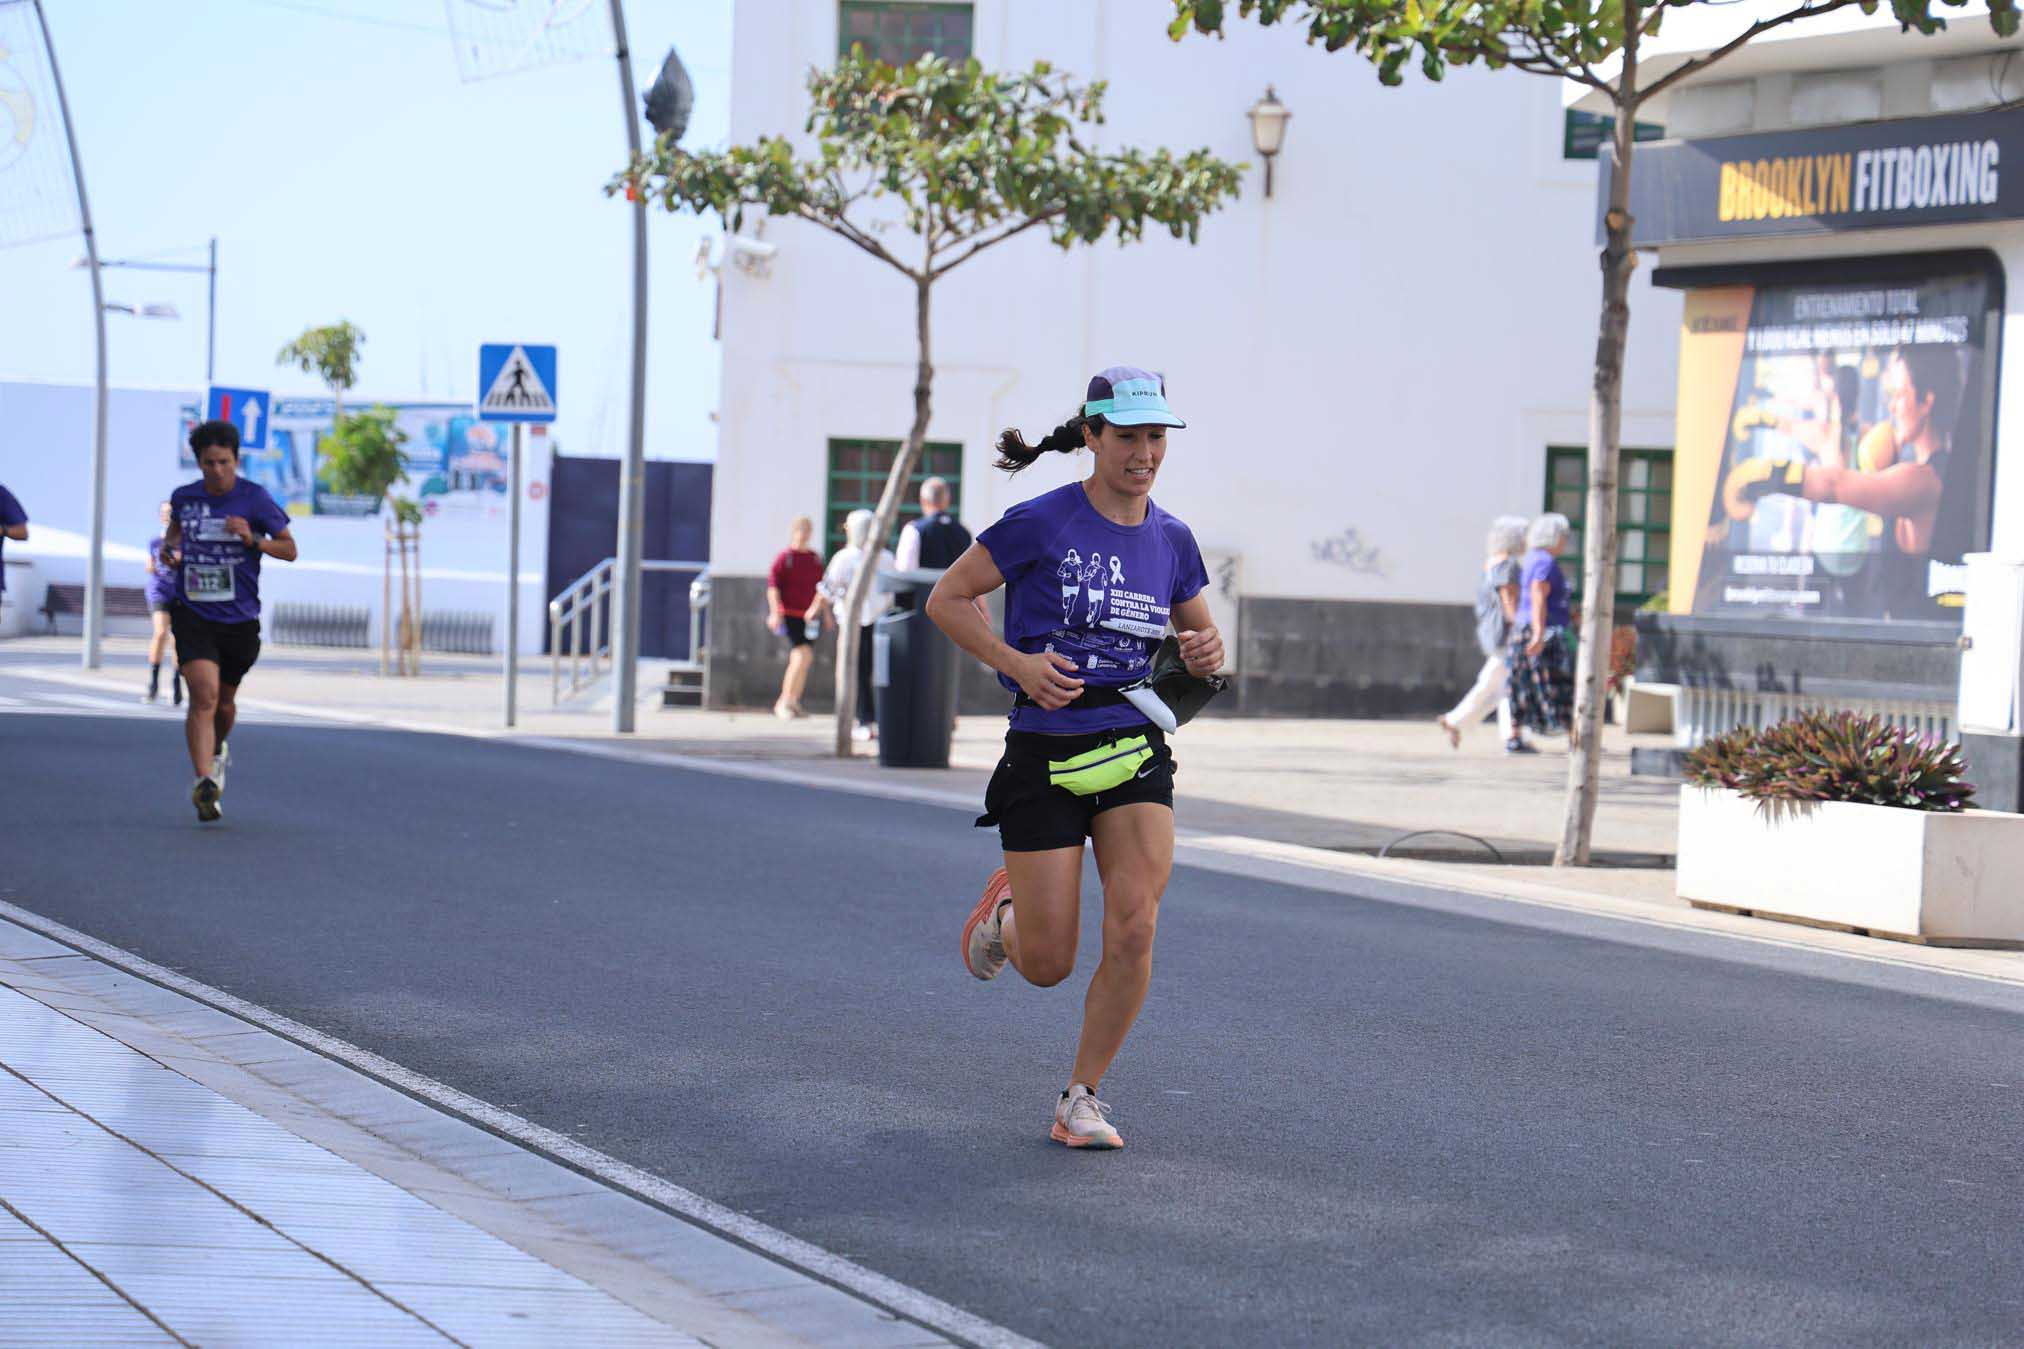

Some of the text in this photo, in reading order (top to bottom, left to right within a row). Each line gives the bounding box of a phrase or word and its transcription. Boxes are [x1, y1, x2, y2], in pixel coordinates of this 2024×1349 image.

[1719, 140, 1999, 221] BROOKLYN FITBOXING
[1110, 588, 1156, 604] XIII CARRERA
[1110, 598, 1140, 610] CONTRA
[1140, 602, 1150, 612] LA
[1110, 607, 1150, 621] DE GÉNERO
